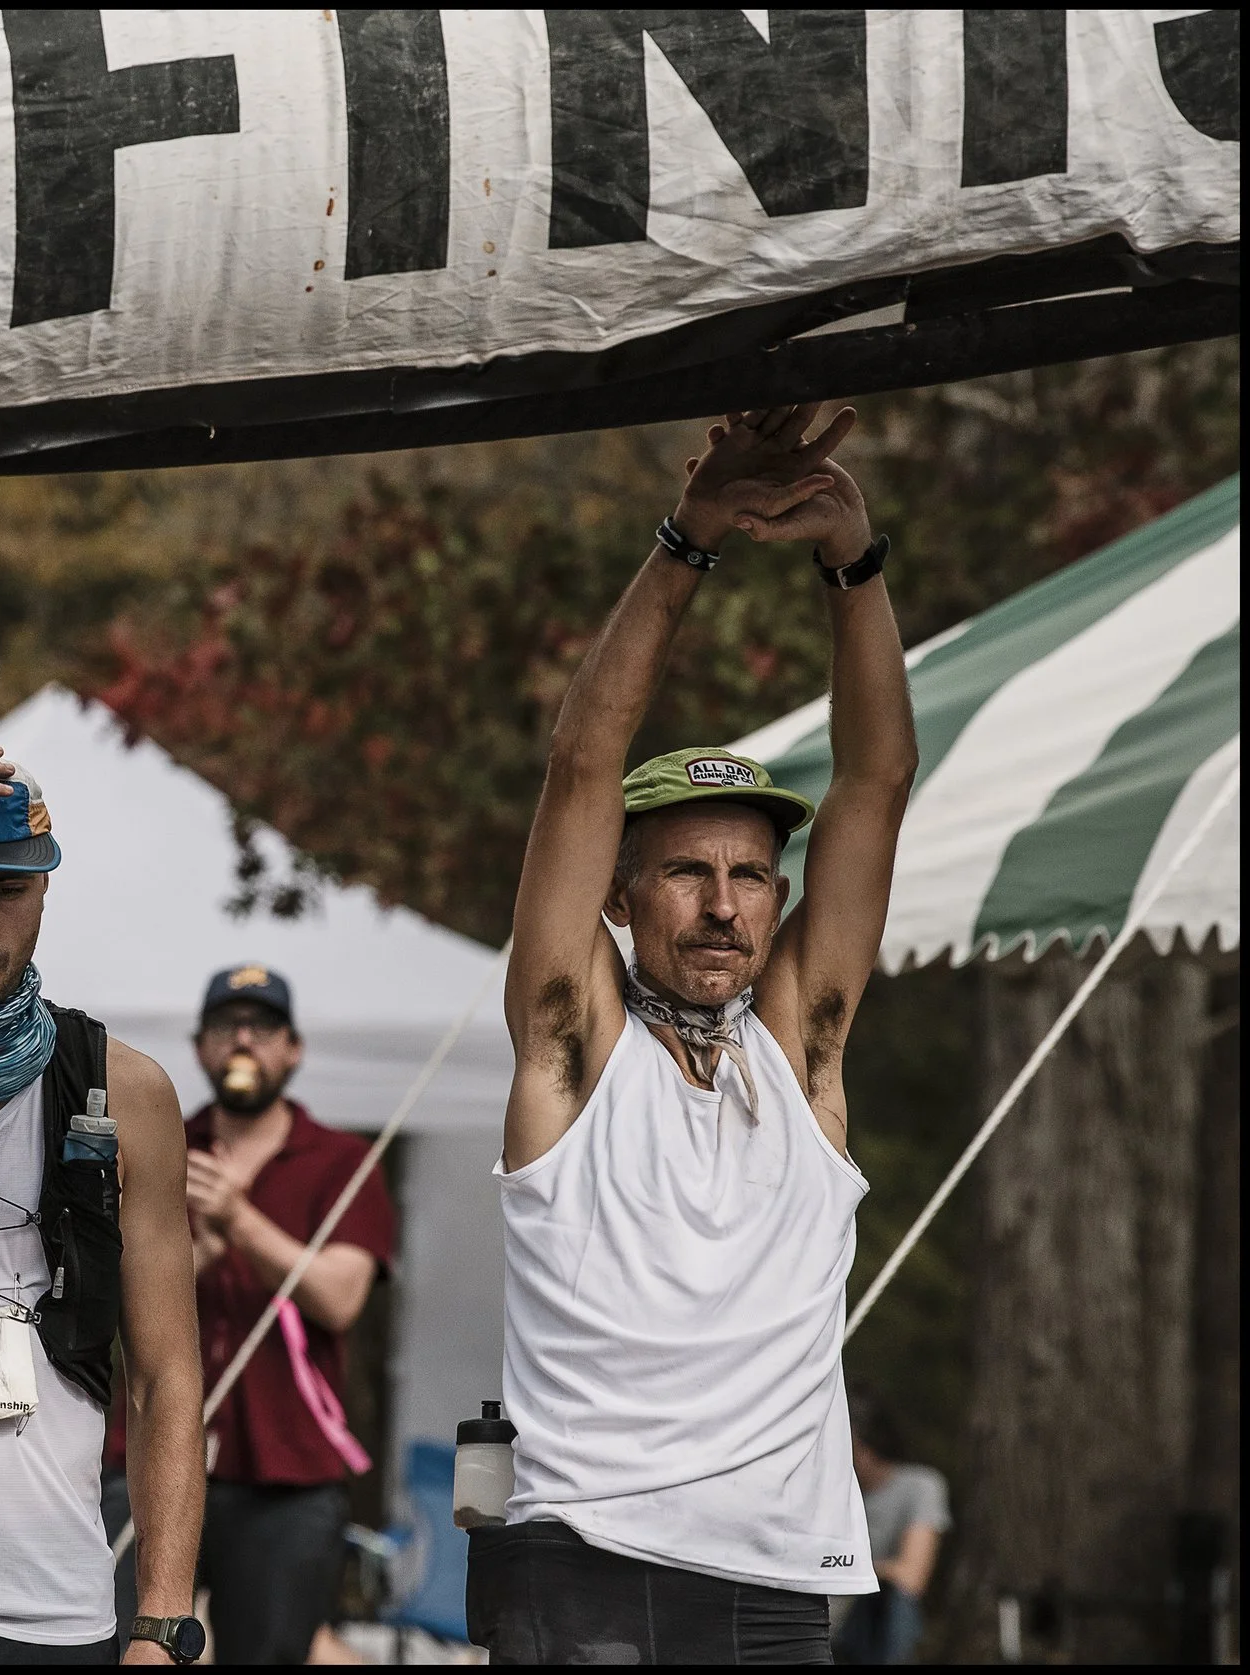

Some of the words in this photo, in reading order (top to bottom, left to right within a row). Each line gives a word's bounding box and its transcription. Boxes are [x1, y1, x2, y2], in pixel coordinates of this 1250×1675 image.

[693, 763, 722, 775] ALL
[725, 764, 751, 779] DAY
[693, 772, 739, 781] RUNNING
[820, 1554, 854, 1568] 2XU
